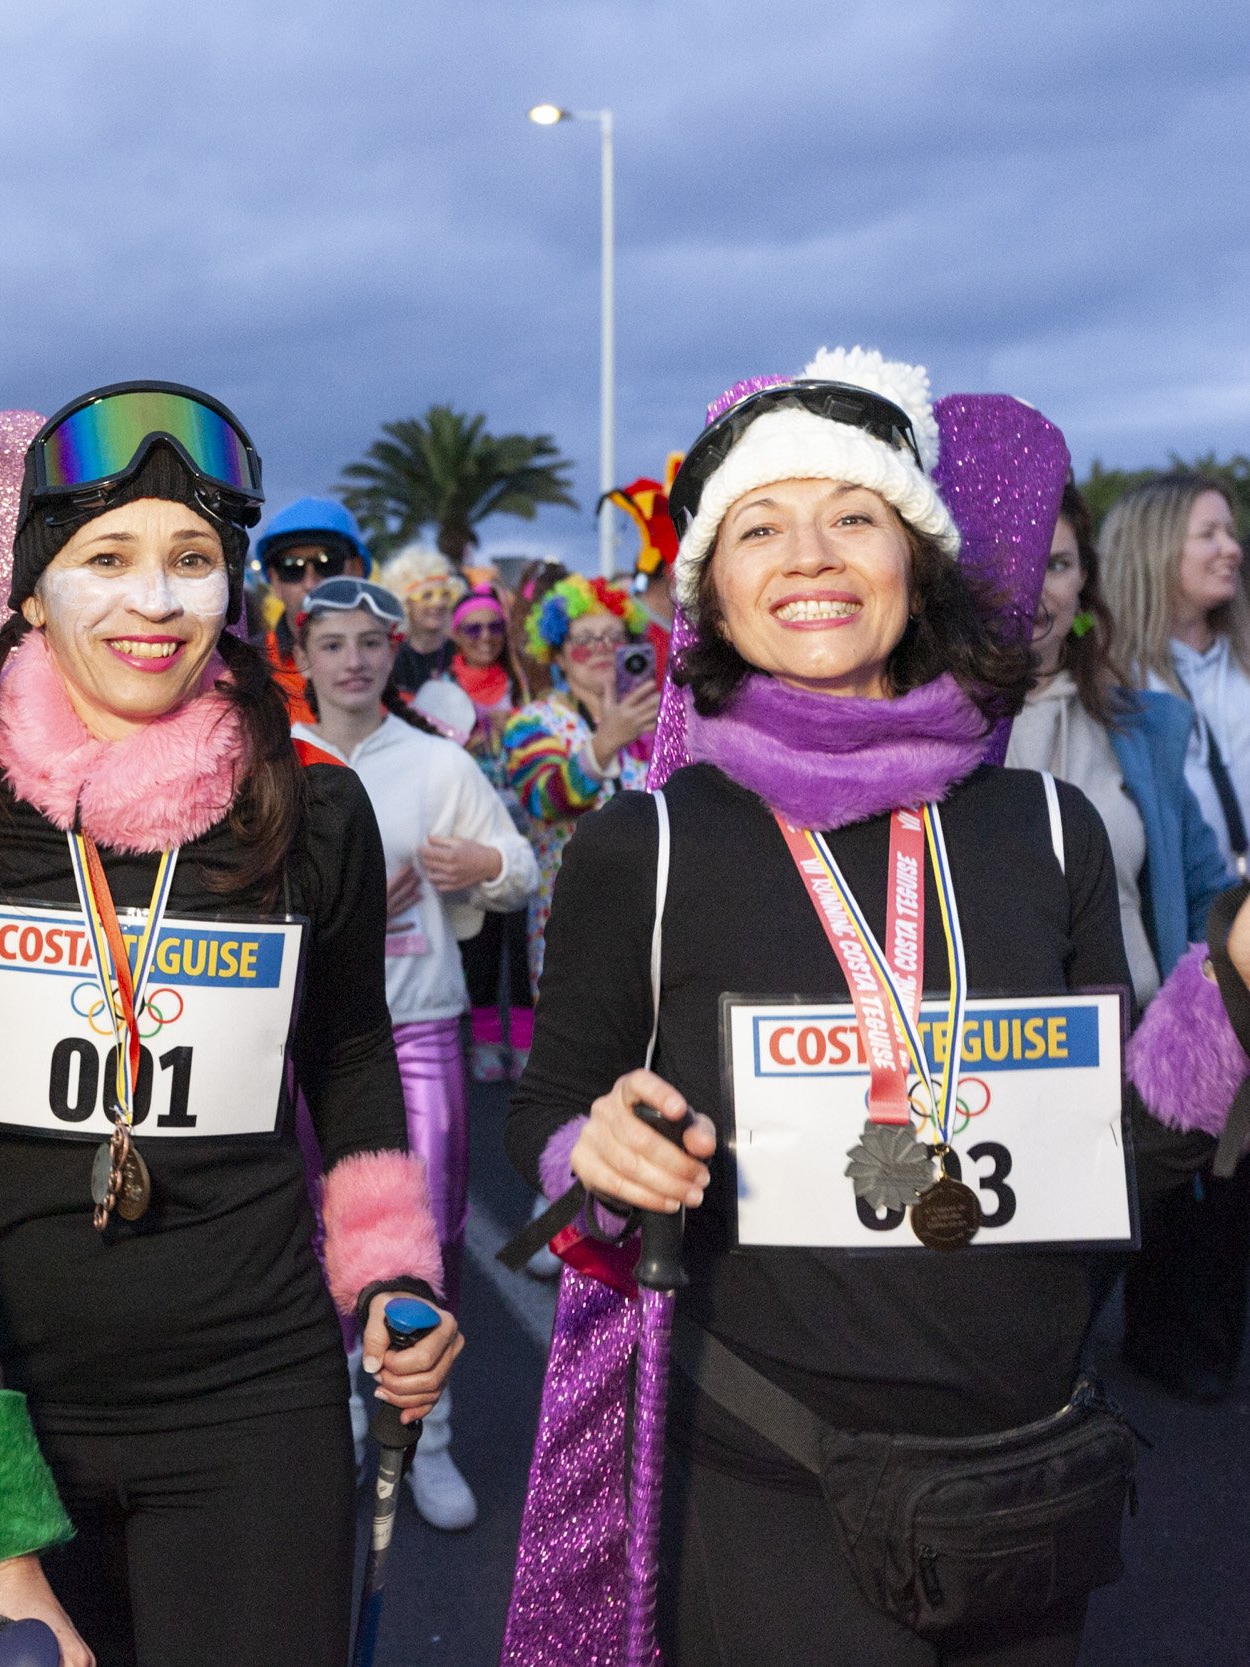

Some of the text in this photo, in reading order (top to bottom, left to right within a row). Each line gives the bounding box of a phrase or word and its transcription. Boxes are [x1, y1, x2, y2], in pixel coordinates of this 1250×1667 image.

[895, 851, 918, 918] TEGUISE
[123, 933, 259, 978] TGUISE
[894, 918, 918, 972] COSTA
[839, 940, 878, 991] COSTA
[860, 996, 897, 1072] TEGUISE
[769, 1026, 868, 1067] COST
[49, 1037, 198, 1128] 001
